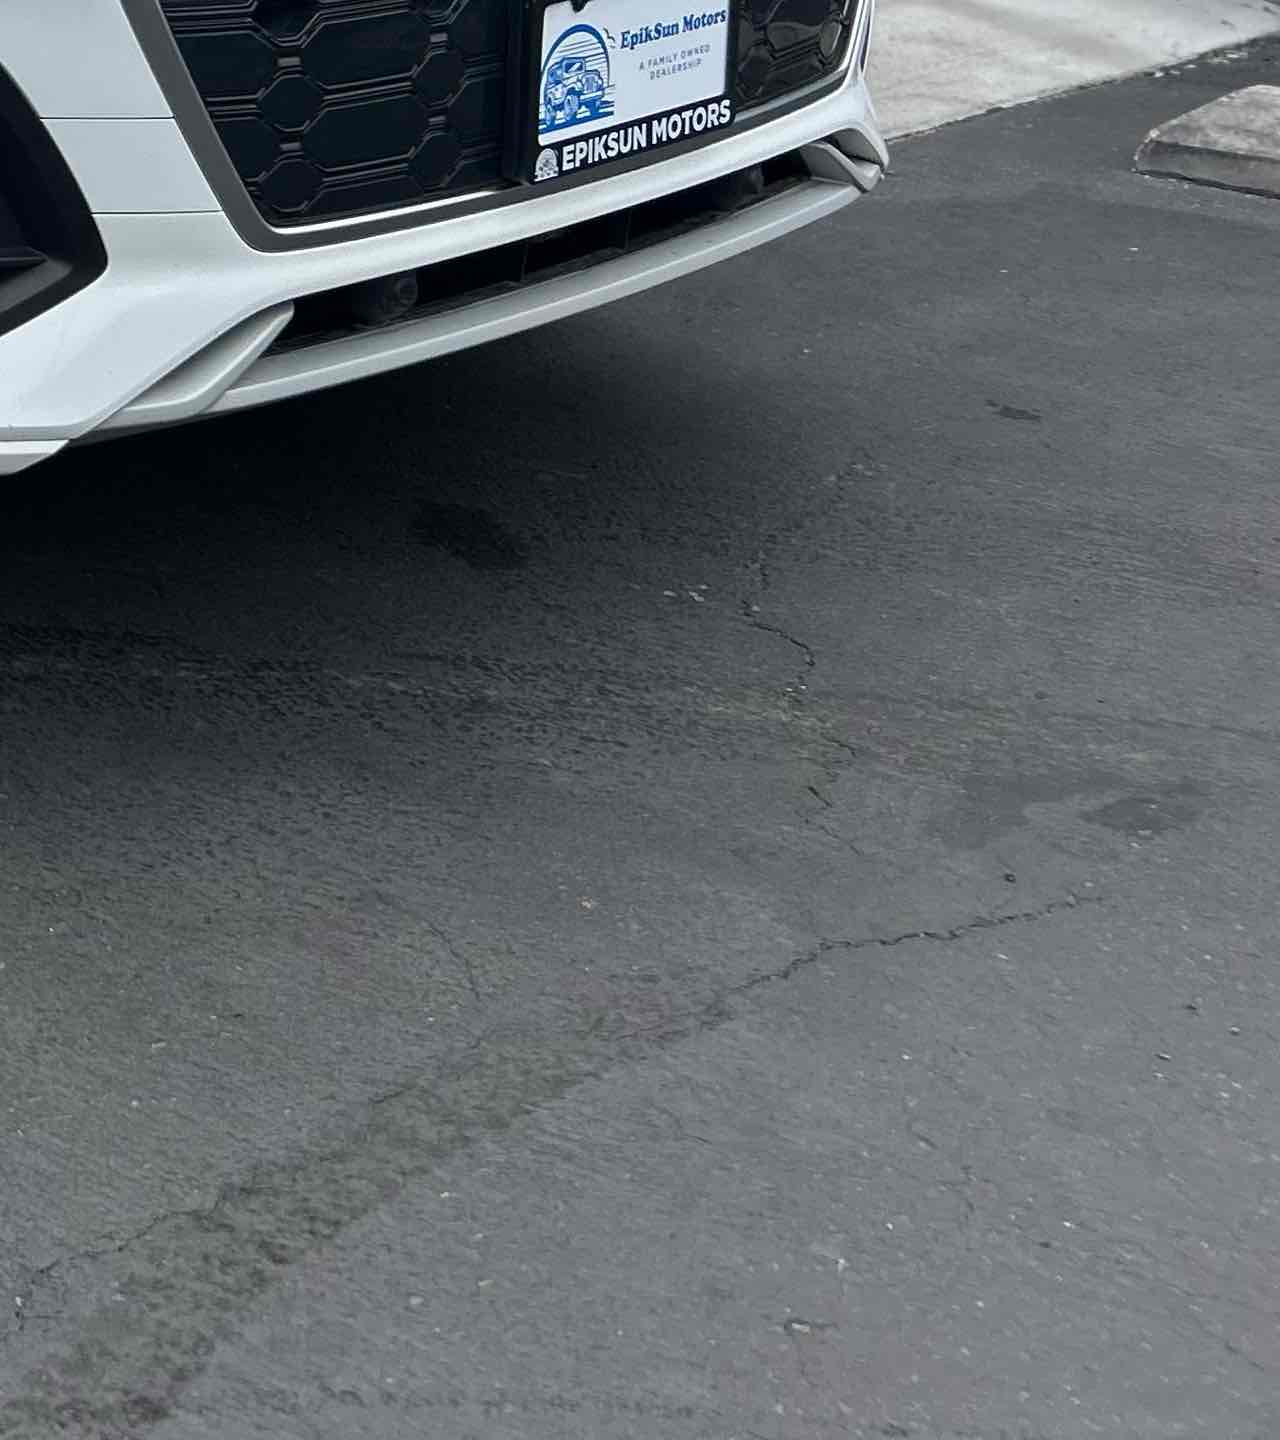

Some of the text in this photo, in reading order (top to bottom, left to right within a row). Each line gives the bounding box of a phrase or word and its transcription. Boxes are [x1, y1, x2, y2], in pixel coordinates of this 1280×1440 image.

[620, 9, 727, 50] EpikSun Motors
[561, 99, 731, 171] EPIKSUN MOTORS
